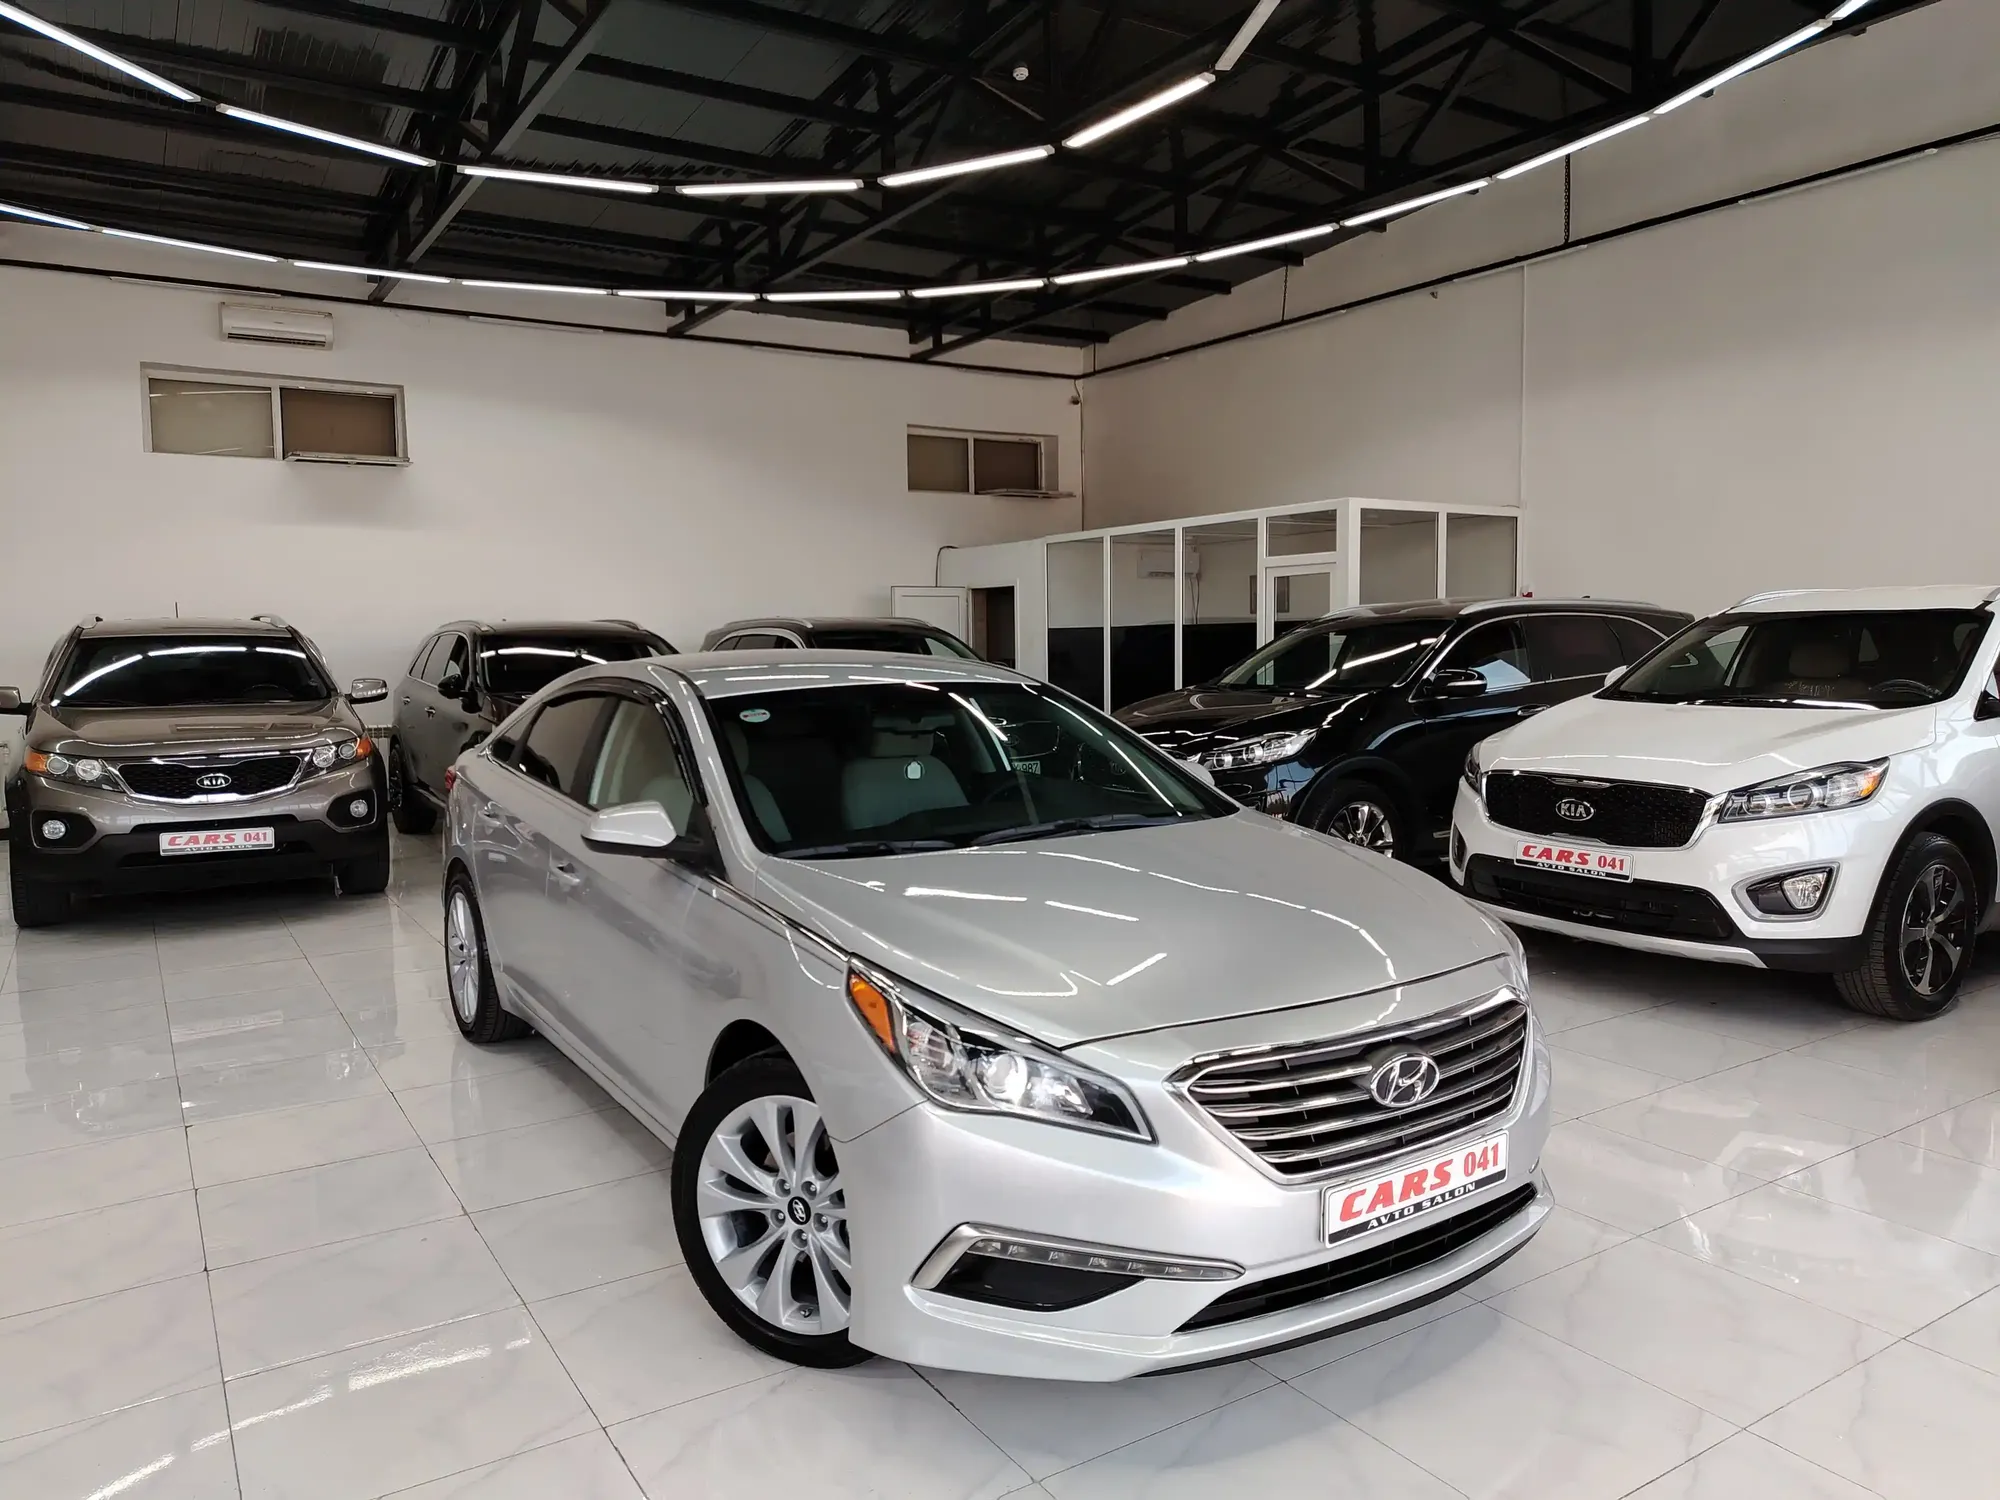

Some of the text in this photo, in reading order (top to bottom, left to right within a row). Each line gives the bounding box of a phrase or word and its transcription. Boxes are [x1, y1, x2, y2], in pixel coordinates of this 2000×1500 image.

[204, 777, 226, 786] KIA
[1561, 803, 1587, 817] KIA
[168, 832, 267, 846] CARS 041
[1522, 845, 1625, 871] CARS 041
[1536, 862, 1606, 877] AVTO SALON
[1339, 1142, 1499, 1222] CARS 041
[1367, 1182, 1476, 1230] AVTO SALON
